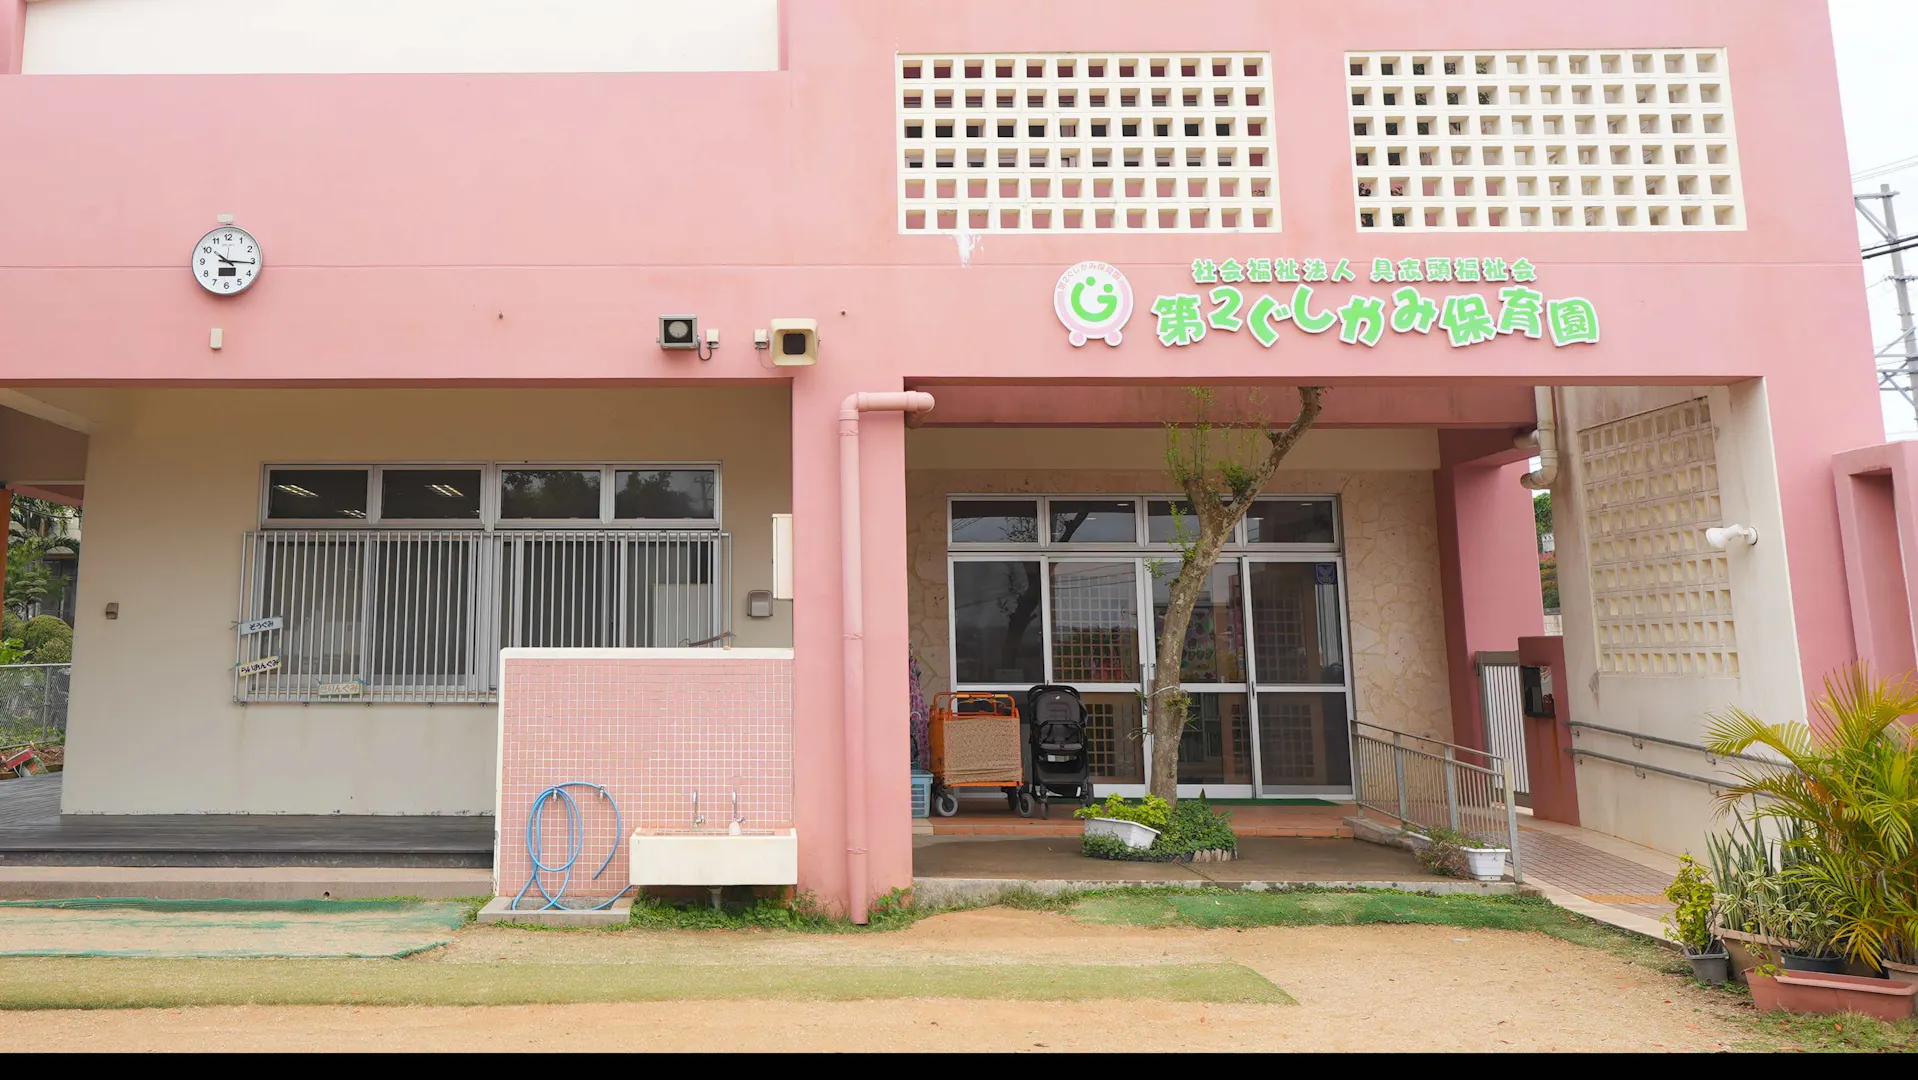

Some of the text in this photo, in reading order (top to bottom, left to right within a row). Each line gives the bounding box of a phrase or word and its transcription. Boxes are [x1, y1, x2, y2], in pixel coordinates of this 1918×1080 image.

[224, 233, 233, 241] 12
[203, 246, 212, 254] 10
[247, 245, 253, 253] 2
[1191, 257, 1537, 284] 社会福祉法人 具志頭福祉会
[212, 278, 218, 286] 7
[236, 278, 242, 286] 5
[1151, 284, 1600, 347] 第2ぐしかみ保育園
